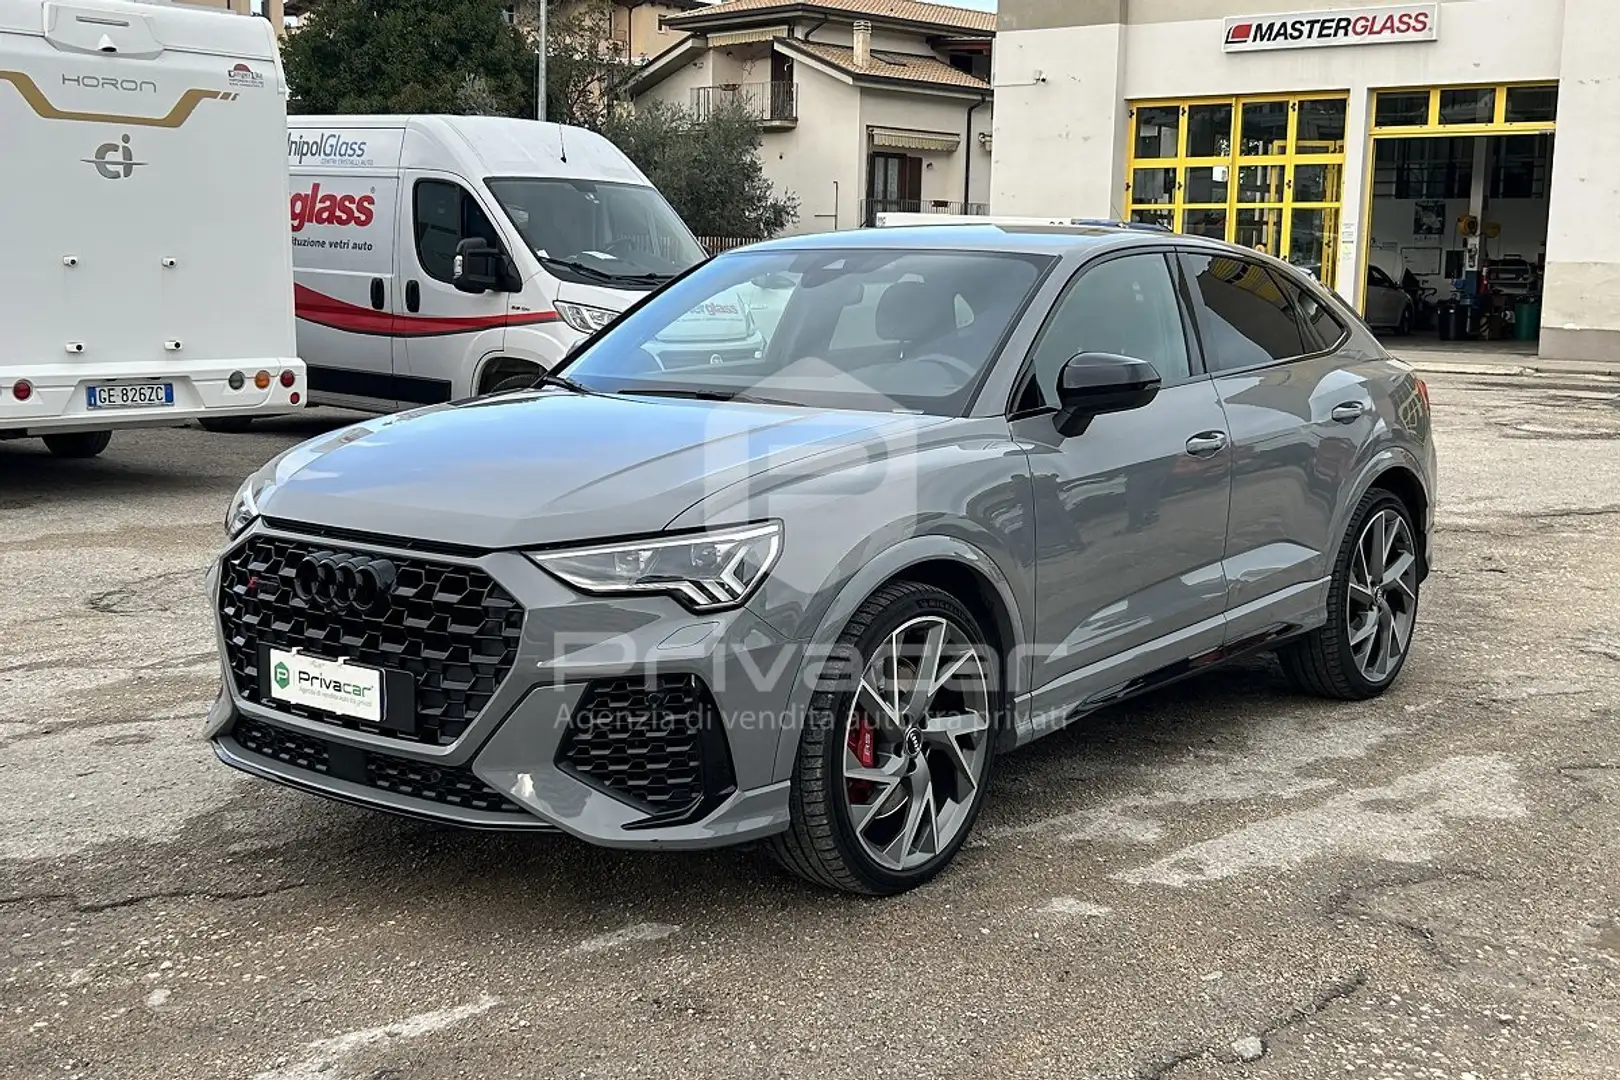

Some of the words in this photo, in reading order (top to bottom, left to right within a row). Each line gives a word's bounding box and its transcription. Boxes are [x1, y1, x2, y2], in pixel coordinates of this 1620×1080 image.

[1252, 12, 1429, 43] MASTERGLASS
[62, 73, 157, 93] HORON
[329, 239, 351, 250] vetri
[351, 242, 373, 252] auto
[99, 387, 116, 403] GE
[121, 386, 163, 403] 826ZC
[298, 670, 372, 697] Privacar
